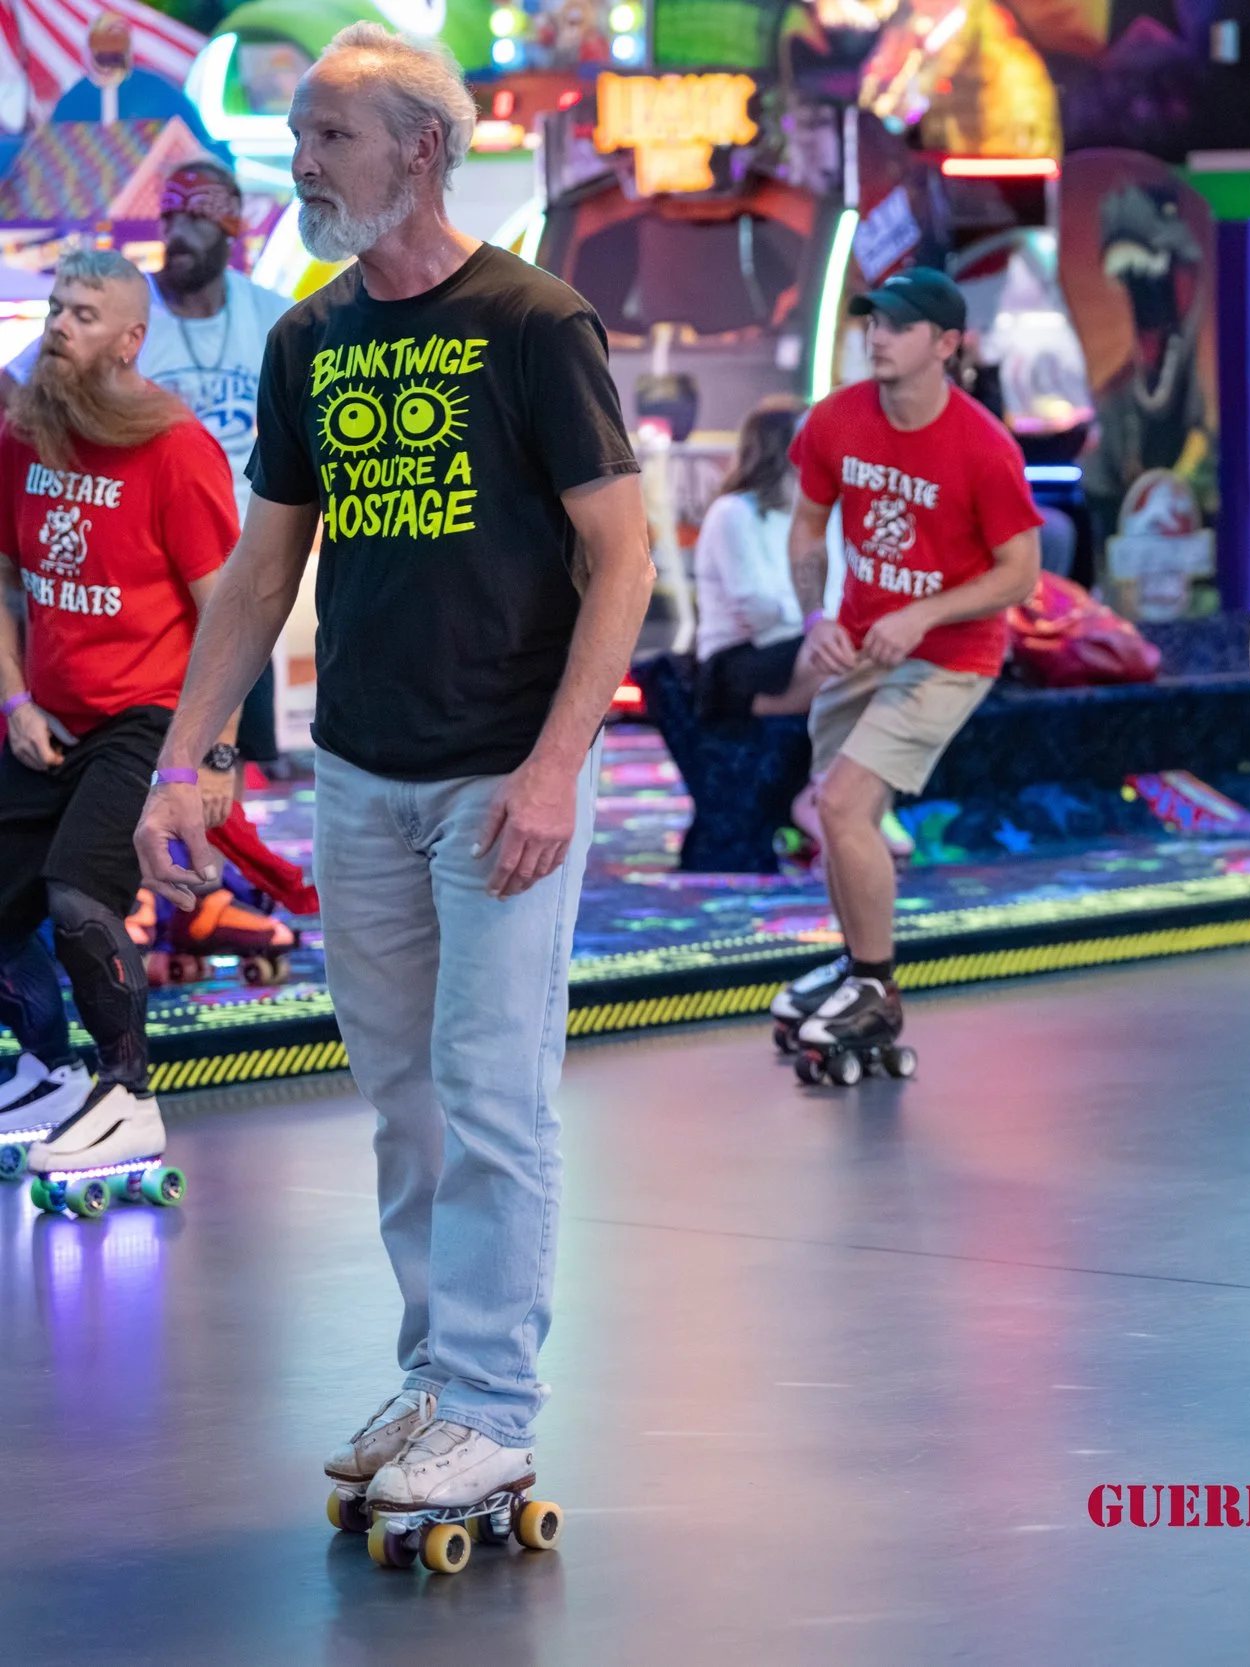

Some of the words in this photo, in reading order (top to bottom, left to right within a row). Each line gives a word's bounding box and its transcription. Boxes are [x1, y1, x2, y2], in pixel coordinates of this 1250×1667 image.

[311, 338, 390, 397] BLINK
[26, 462, 125, 509] UPSTATE
[321, 462, 339, 492] IF
[344, 455, 436, 491] YOU'RE
[444, 451, 472, 485] A
[842, 455, 941, 510] UPSTATE
